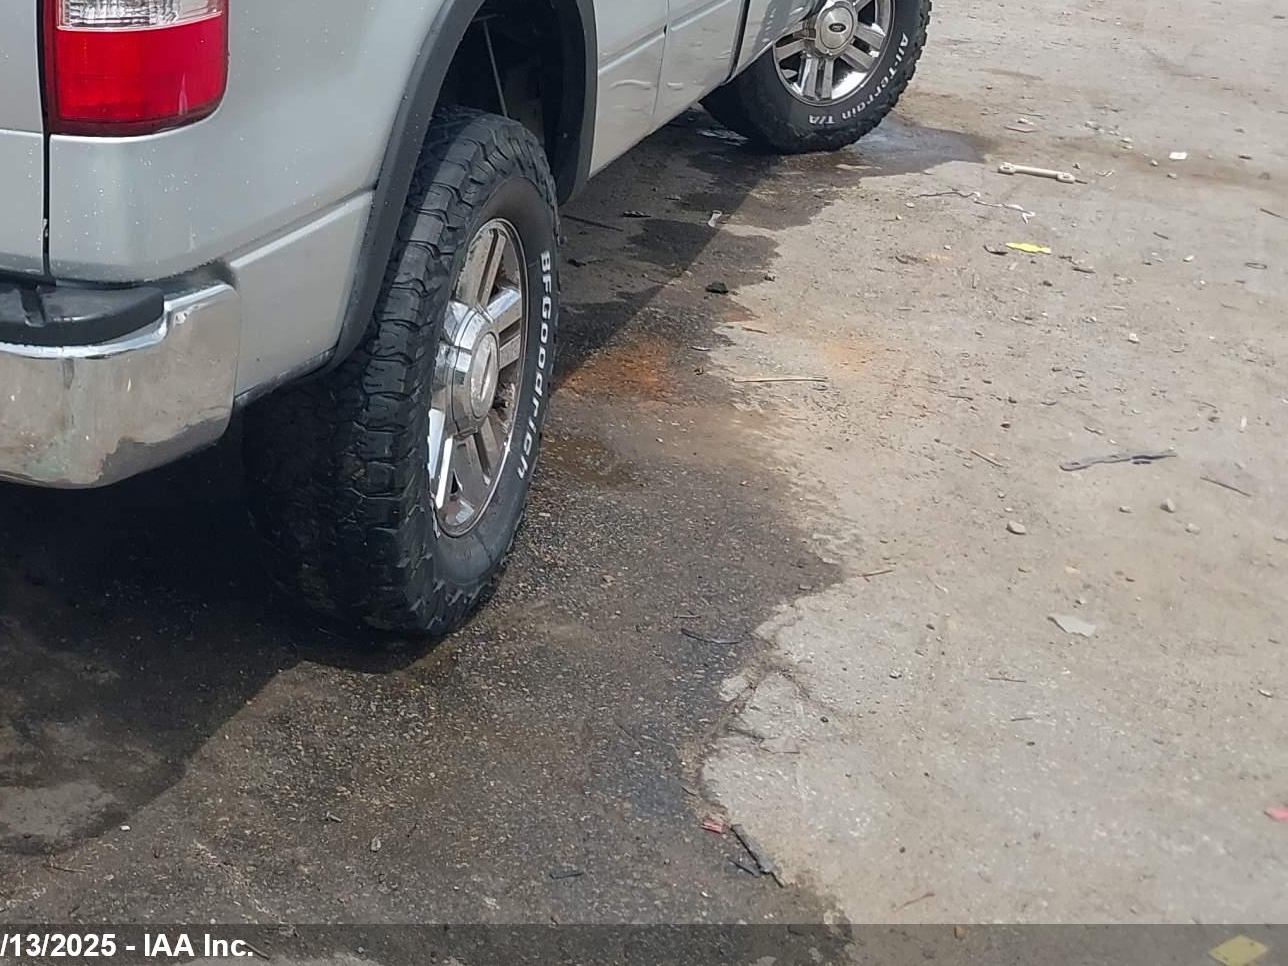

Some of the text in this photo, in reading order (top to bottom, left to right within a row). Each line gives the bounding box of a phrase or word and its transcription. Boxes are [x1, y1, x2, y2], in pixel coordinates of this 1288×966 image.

[808, 32, 909, 125] All-Terrain T/A
[517, 251, 552, 480] BFGoodrich
